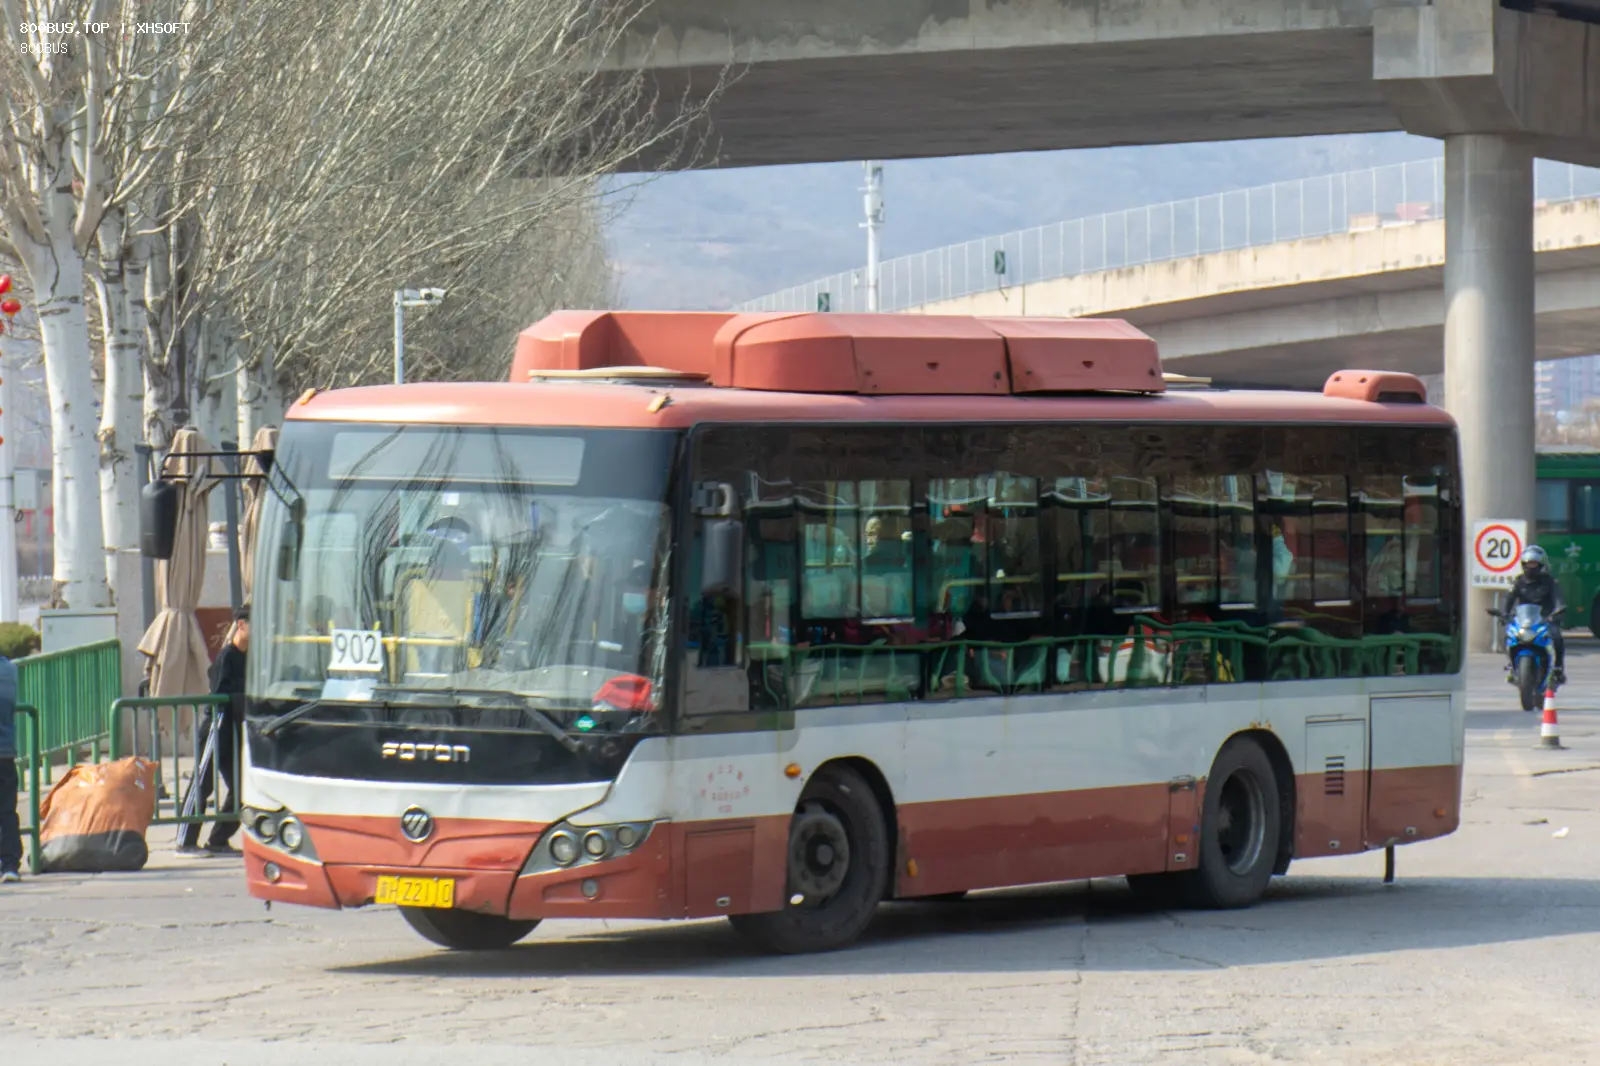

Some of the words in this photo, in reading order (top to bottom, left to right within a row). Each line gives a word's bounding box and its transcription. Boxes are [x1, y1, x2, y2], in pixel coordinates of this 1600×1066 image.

[1487, 538, 1511, 558] 20
[335, 633, 379, 664] 902
[382, 742, 470, 762] FOTON
